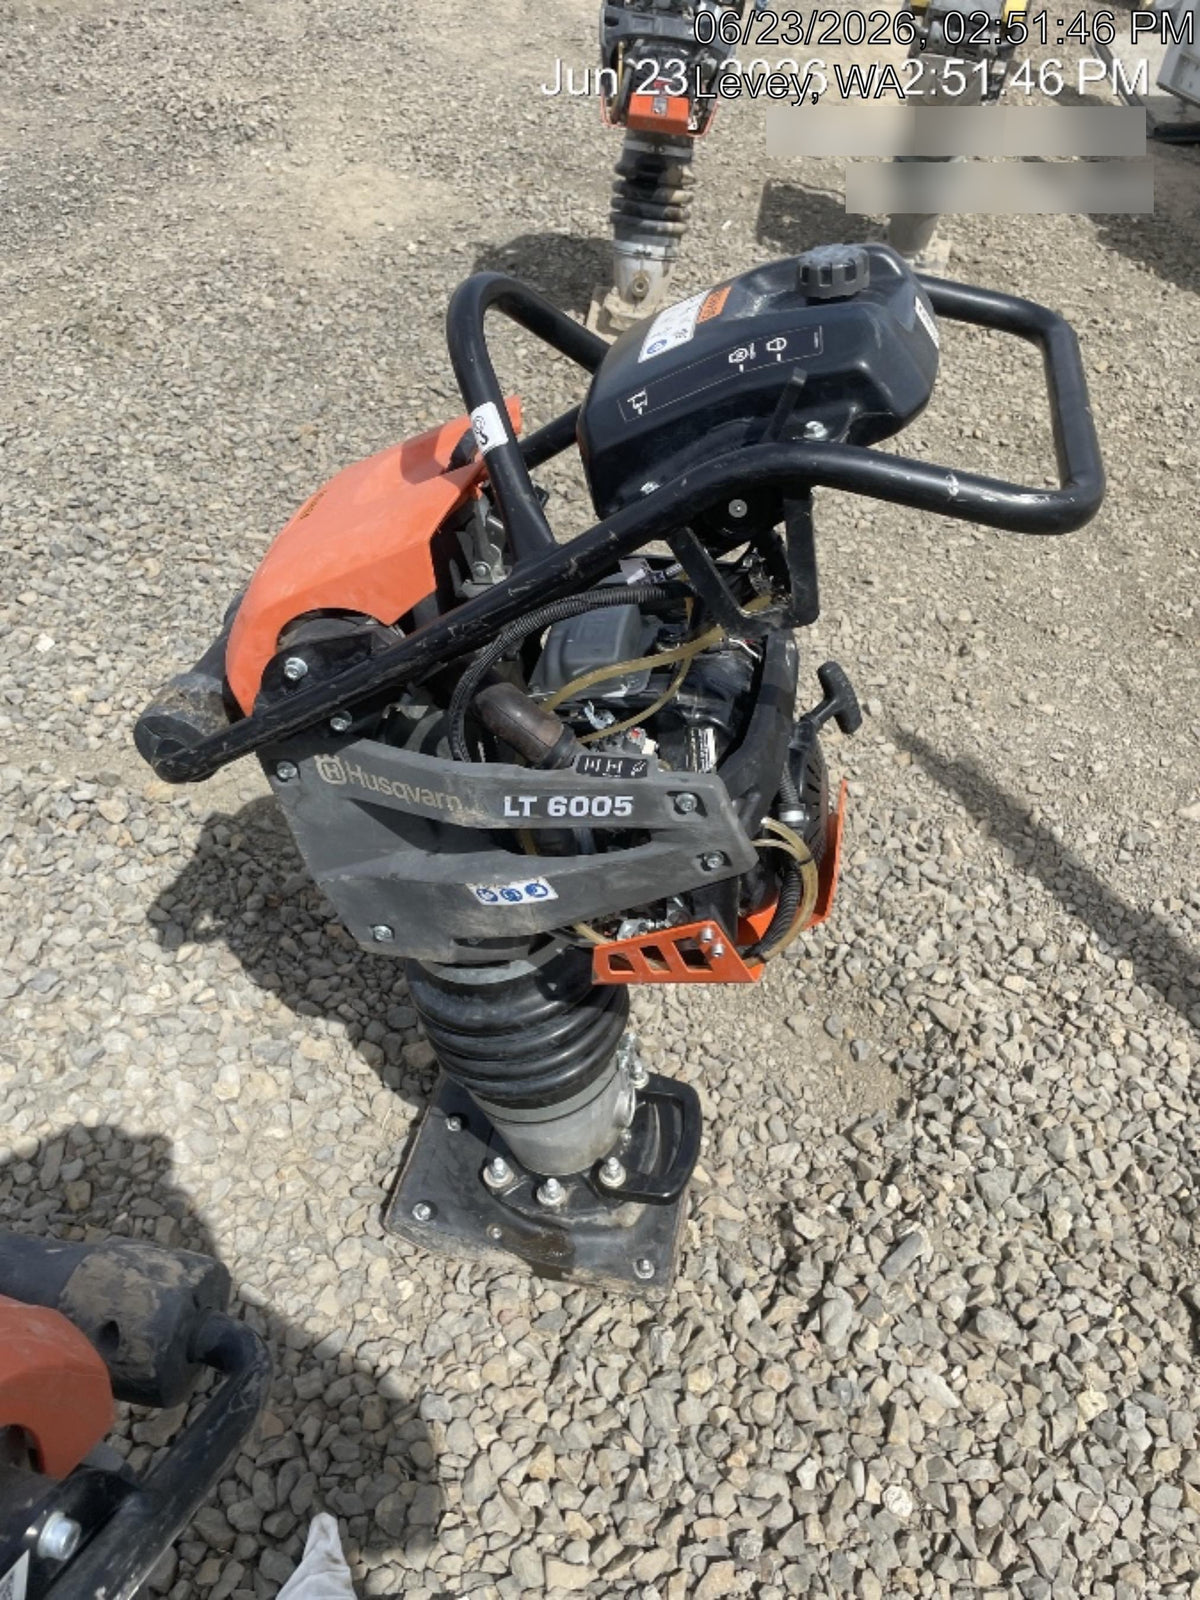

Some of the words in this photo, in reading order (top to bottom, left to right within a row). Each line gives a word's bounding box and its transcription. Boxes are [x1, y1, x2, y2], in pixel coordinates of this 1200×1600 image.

[344, 761, 463, 811] Husqvarn
[504, 796, 538, 817] LT
[547, 796, 635, 817] 6005
